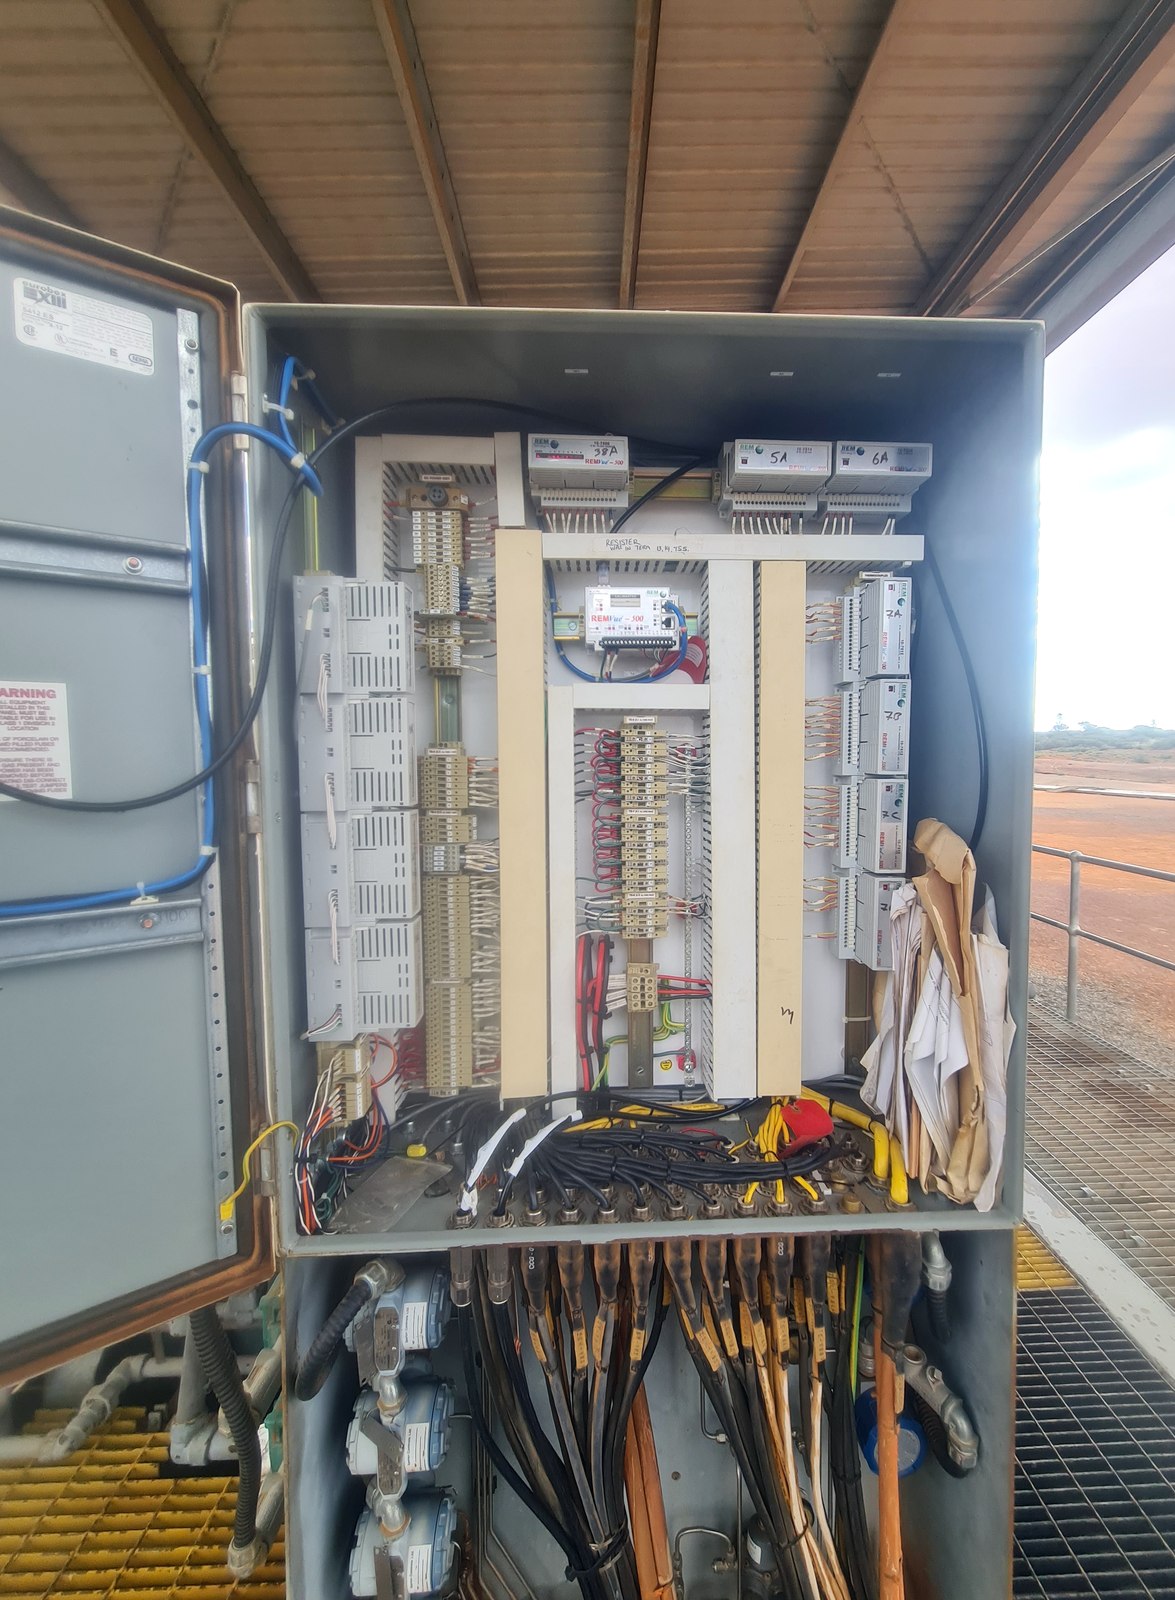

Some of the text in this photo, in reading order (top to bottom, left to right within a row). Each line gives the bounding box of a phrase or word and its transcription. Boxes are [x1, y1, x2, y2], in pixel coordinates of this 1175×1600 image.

[594, 446, 618, 457] 38A
[770, 451, 787, 464] 5A
[872, 451, 888, 465] 6A
[886, 609, 902, 619] 7A
[0, 687, 56, 698] ARNING
